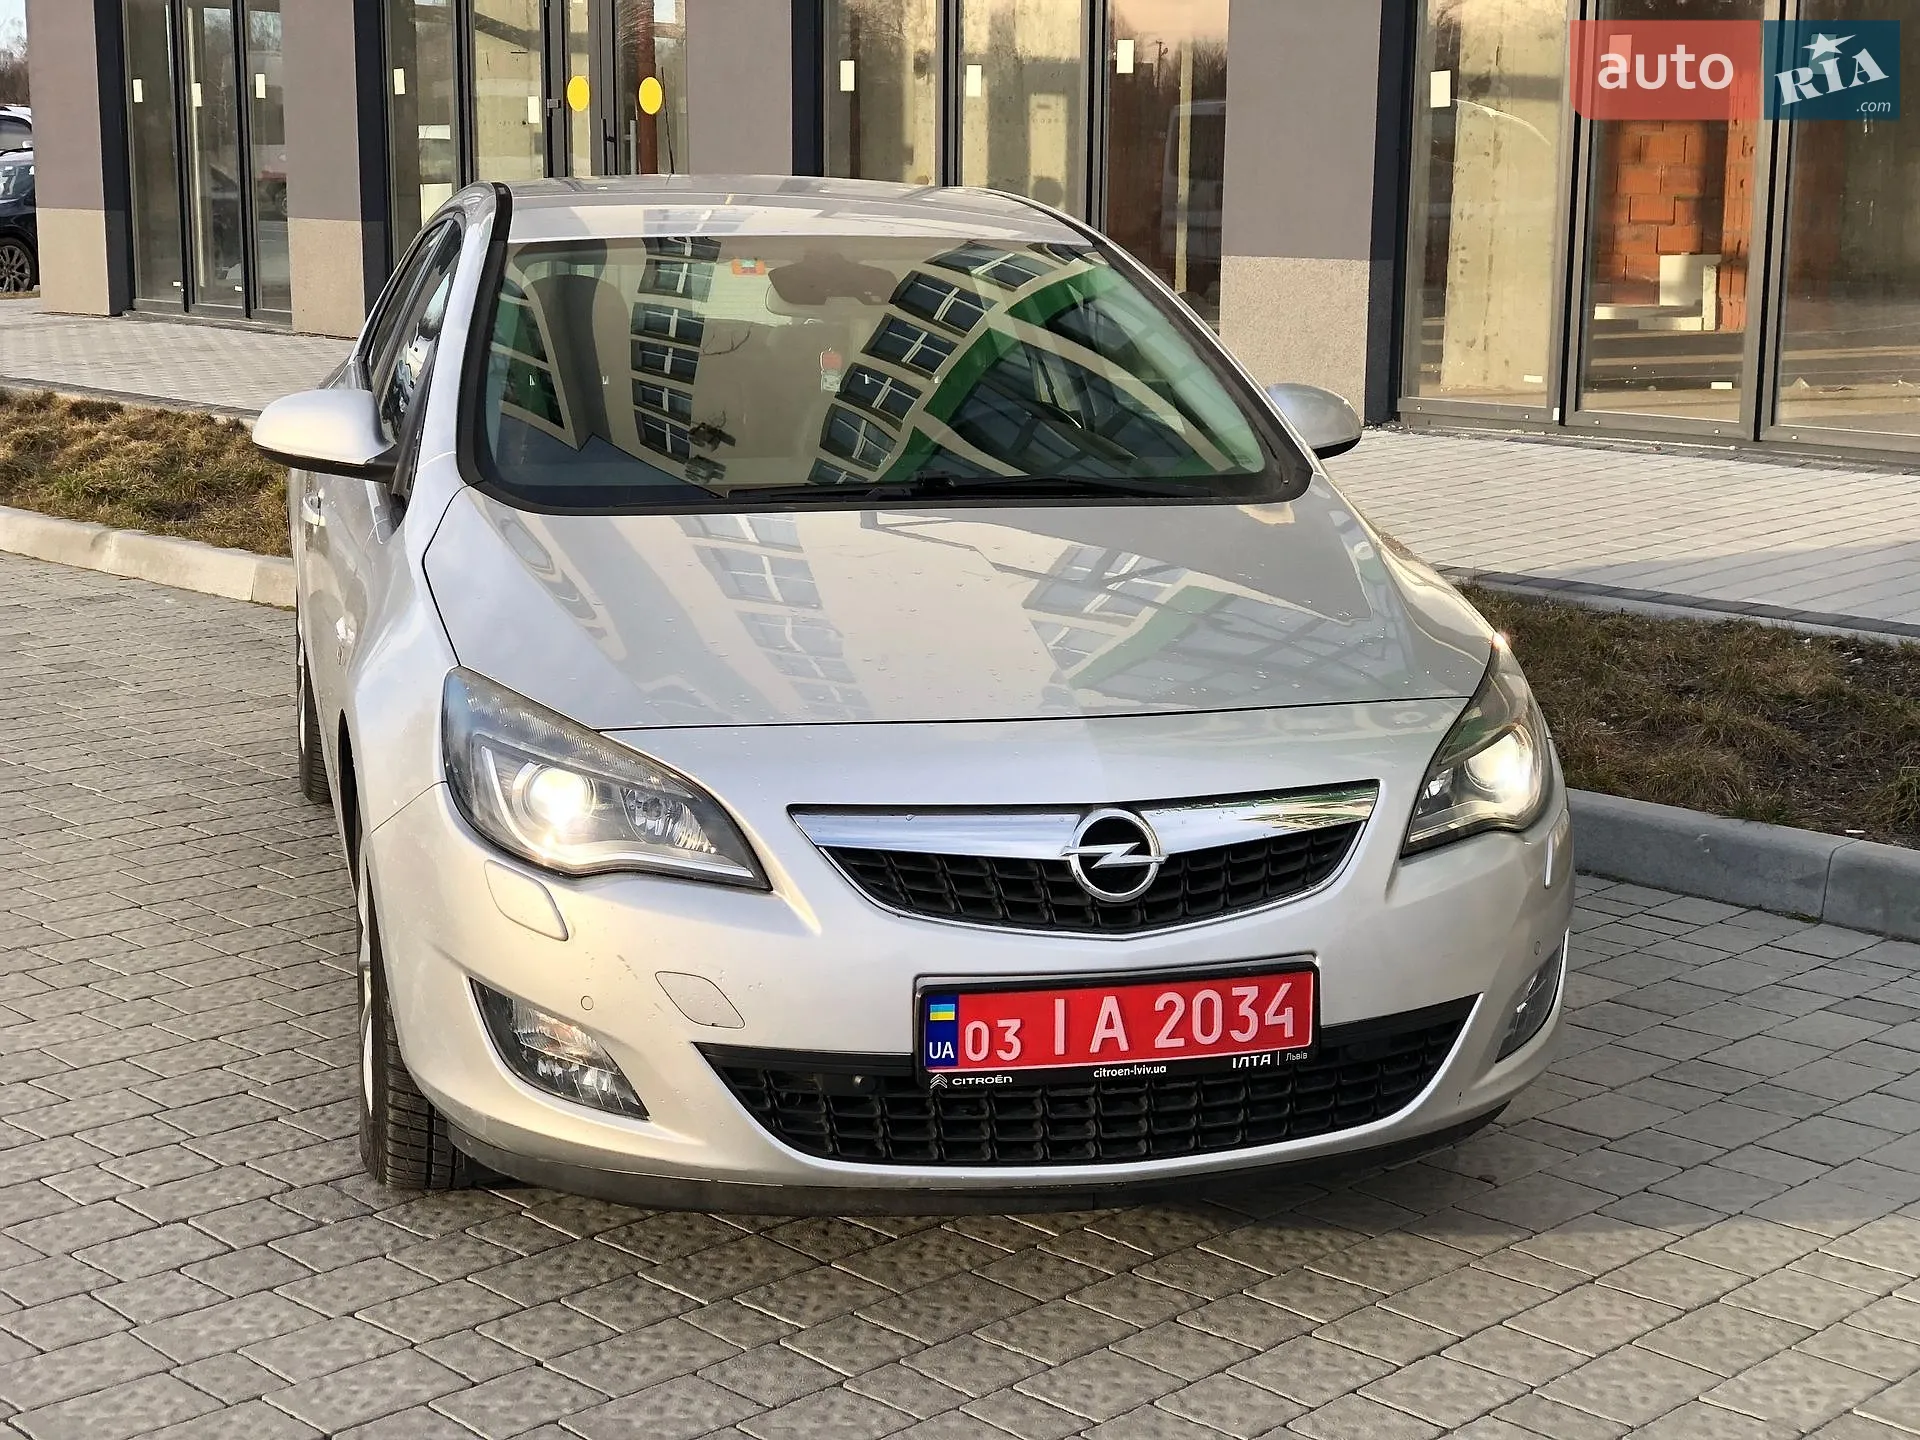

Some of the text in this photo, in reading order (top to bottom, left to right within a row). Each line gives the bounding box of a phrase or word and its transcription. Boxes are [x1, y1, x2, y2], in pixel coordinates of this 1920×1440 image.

[964, 1019, 1023, 1062] 03
[1154, 982, 1294, 1049] 2034
[928, 1041, 955, 1060] UA
[1093, 1064, 1167, 1078] citroen-lviv.ua
